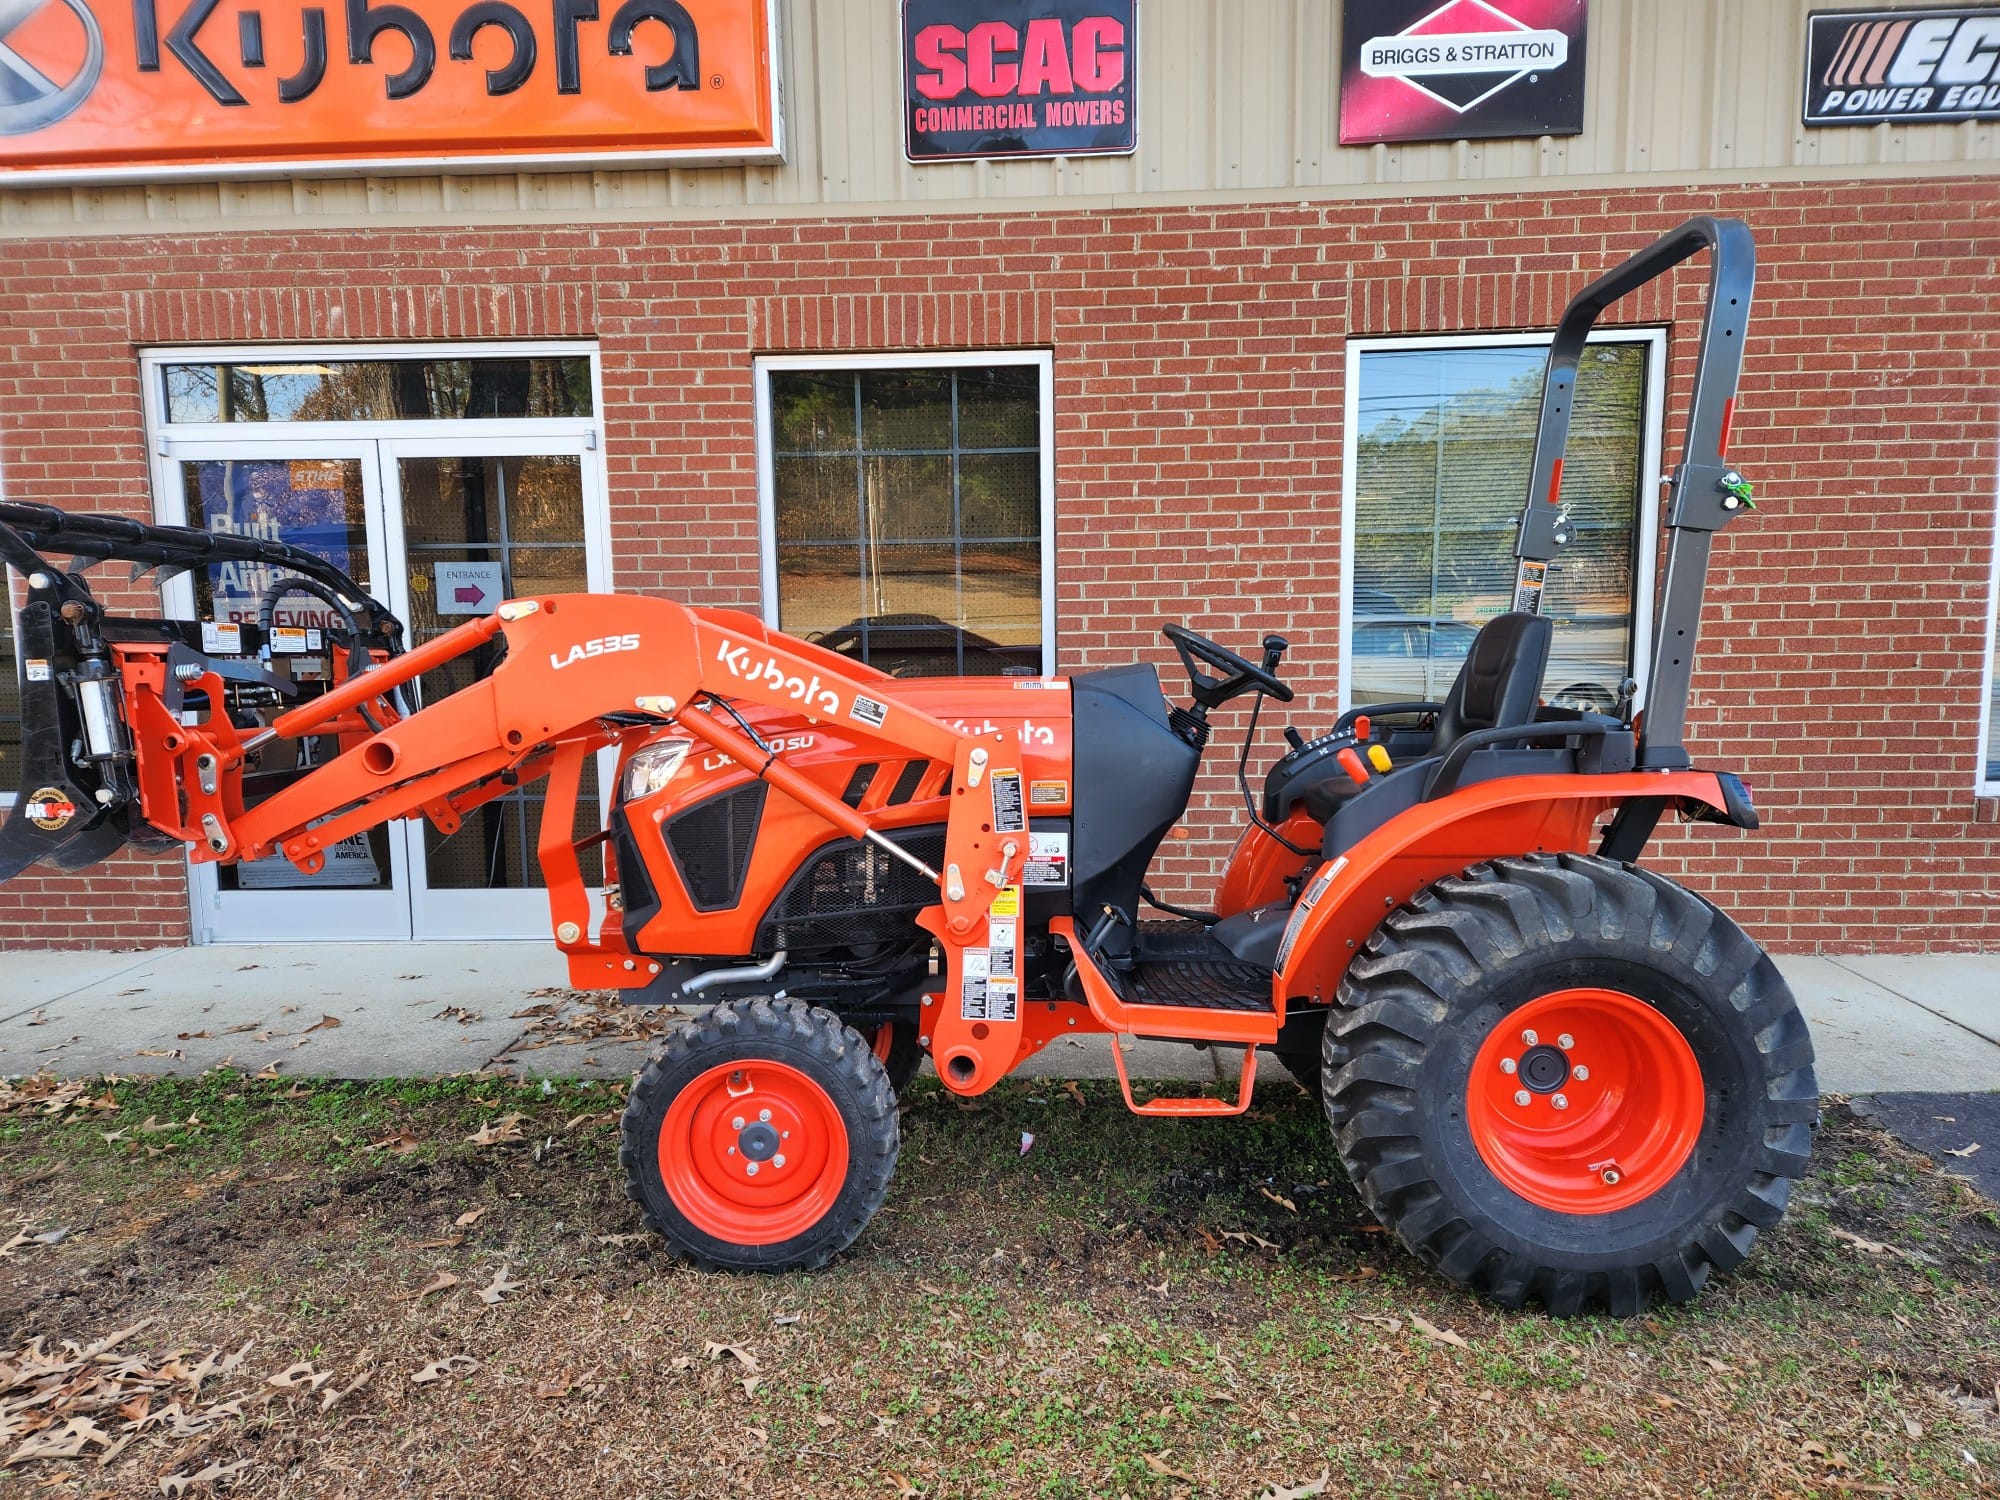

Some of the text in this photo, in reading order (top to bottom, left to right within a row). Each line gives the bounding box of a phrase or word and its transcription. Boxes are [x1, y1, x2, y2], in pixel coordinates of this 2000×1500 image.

[132, 0, 701, 106] Kubota
[914, 16, 1125, 100] SCAG
[1371, 42, 1555, 66] BRIGGS & STRATTON
[1888, 17, 2000, 85] EC
[915, 100, 1125, 133] COMMERCIAL MOWERS
[1820, 87, 1935, 114] POWER
[446, 571, 492, 579] ENTRANCE
[228, 610, 343, 628] BEEVING
[550, 633, 641, 670] LA535
[716, 639, 840, 715] Kubota
